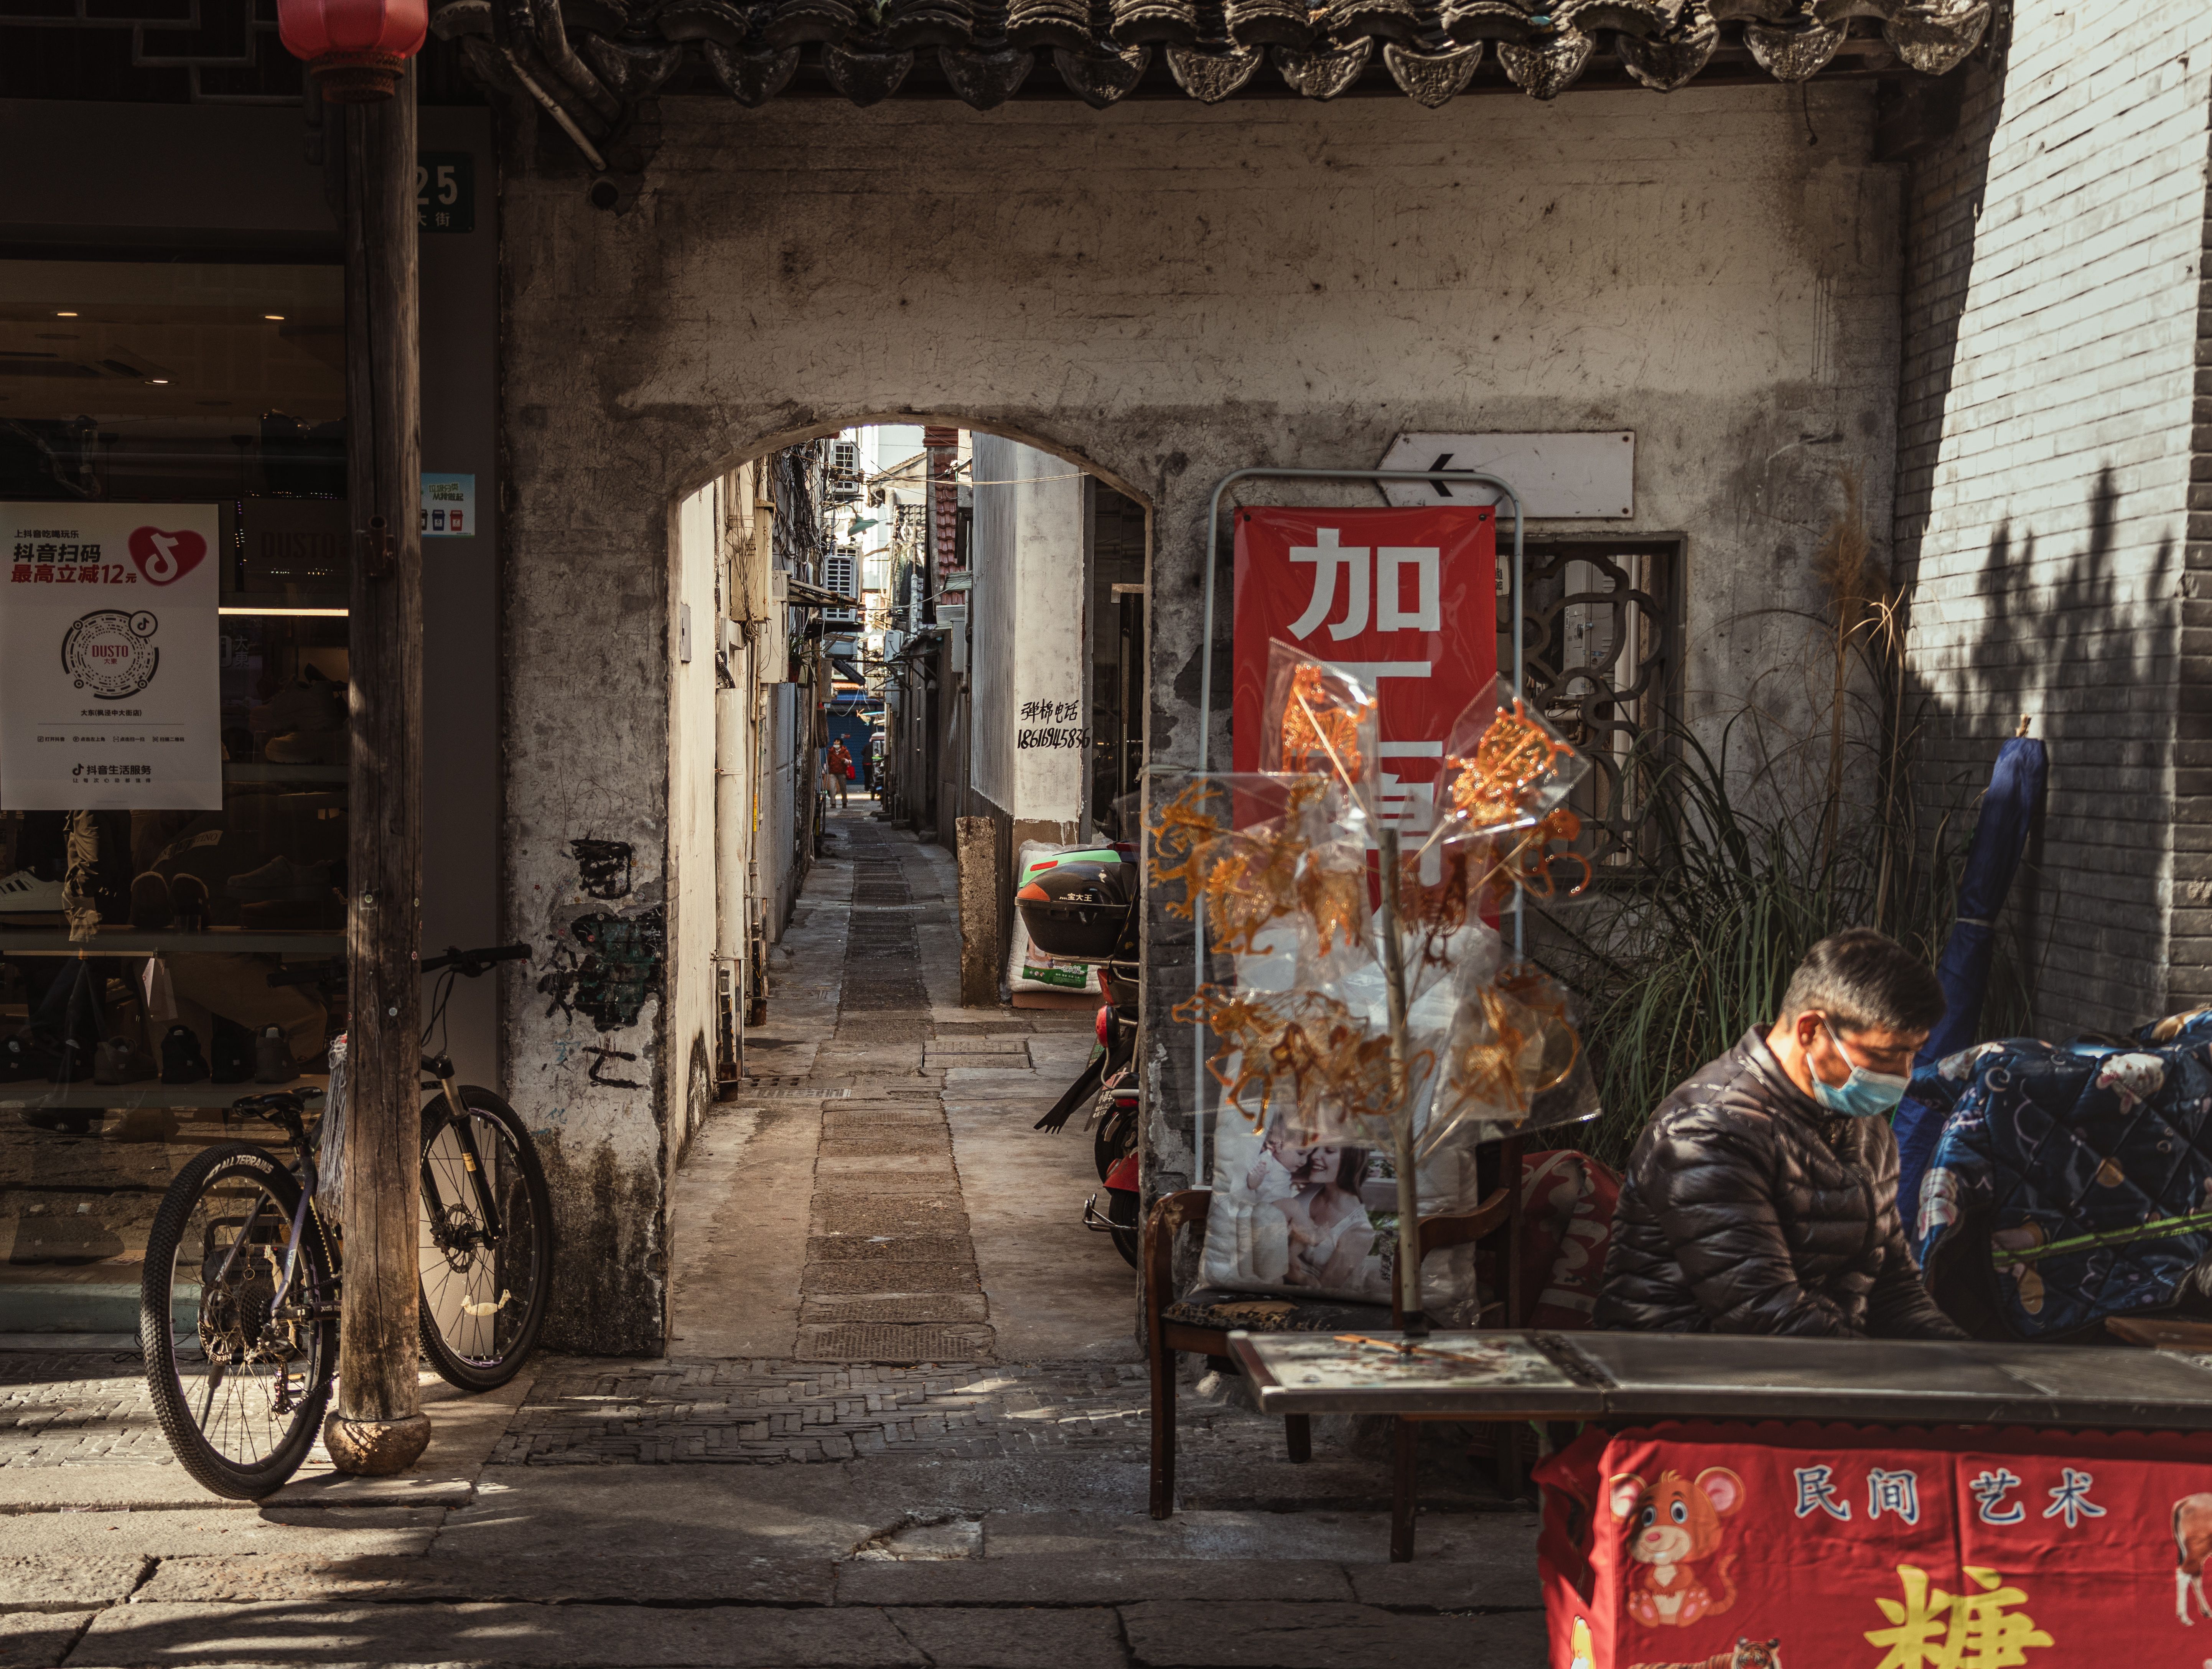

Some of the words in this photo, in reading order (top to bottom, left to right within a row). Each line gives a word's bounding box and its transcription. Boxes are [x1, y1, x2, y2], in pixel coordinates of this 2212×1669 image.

[428, 483, 459, 493] 垃圾分类
[14, 529, 79, 538] 上抖音吃喝玩乐
[13, 543, 100, 563] 抖音扫码
[262, 532, 335, 559] DUSTO
[11, 564, 137, 583] 最高立减12元
[92, 645, 128, 657] DUSTO
[1020, 698, 1079, 725] 弹棉电话
[1017, 727, 1090, 750] 18616945836
[87, 765, 152, 775] 抖音生活服务
